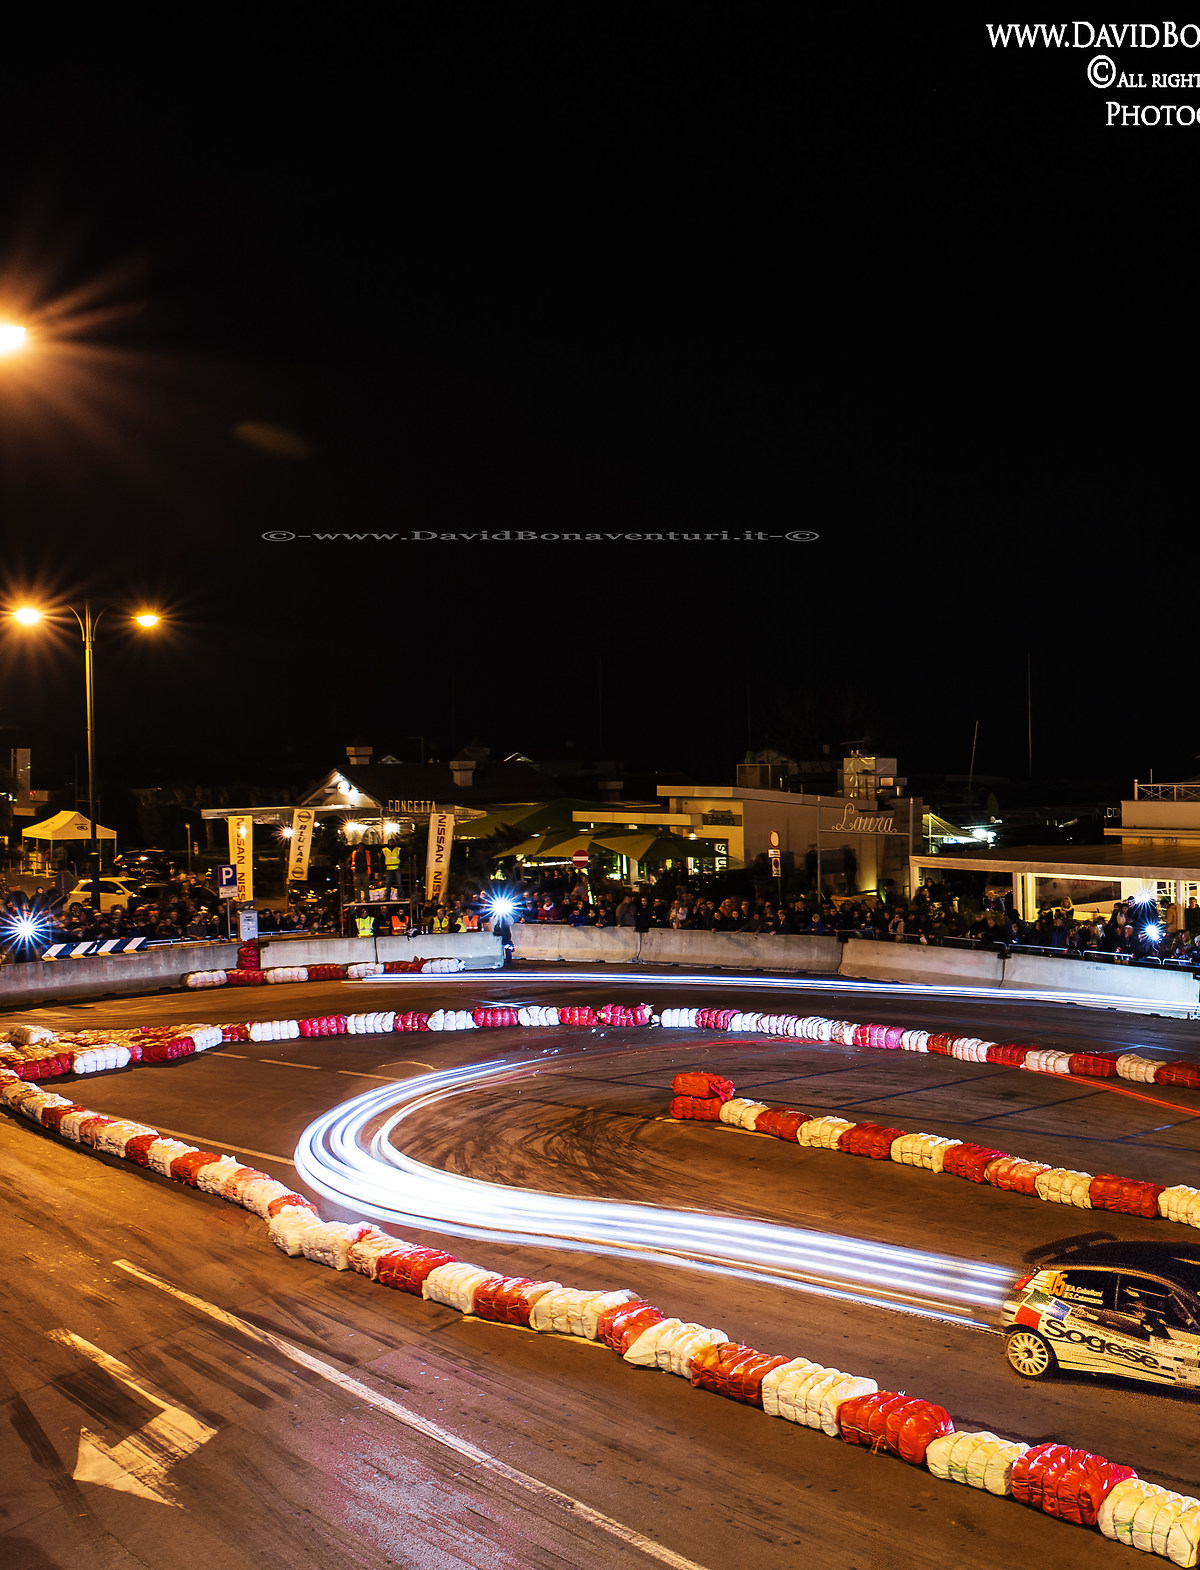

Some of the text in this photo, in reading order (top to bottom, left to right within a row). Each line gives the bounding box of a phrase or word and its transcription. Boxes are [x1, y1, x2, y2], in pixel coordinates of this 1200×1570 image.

[388, 799, 437, 813] CONCETTA
[831, 803, 898, 833] Laura
[295, 824, 307, 864] BLU CAR
[434, 814, 447, 863] NISSAN
[222, 867, 233, 885] P
[1044, 1319, 1160, 1369] Sogese
